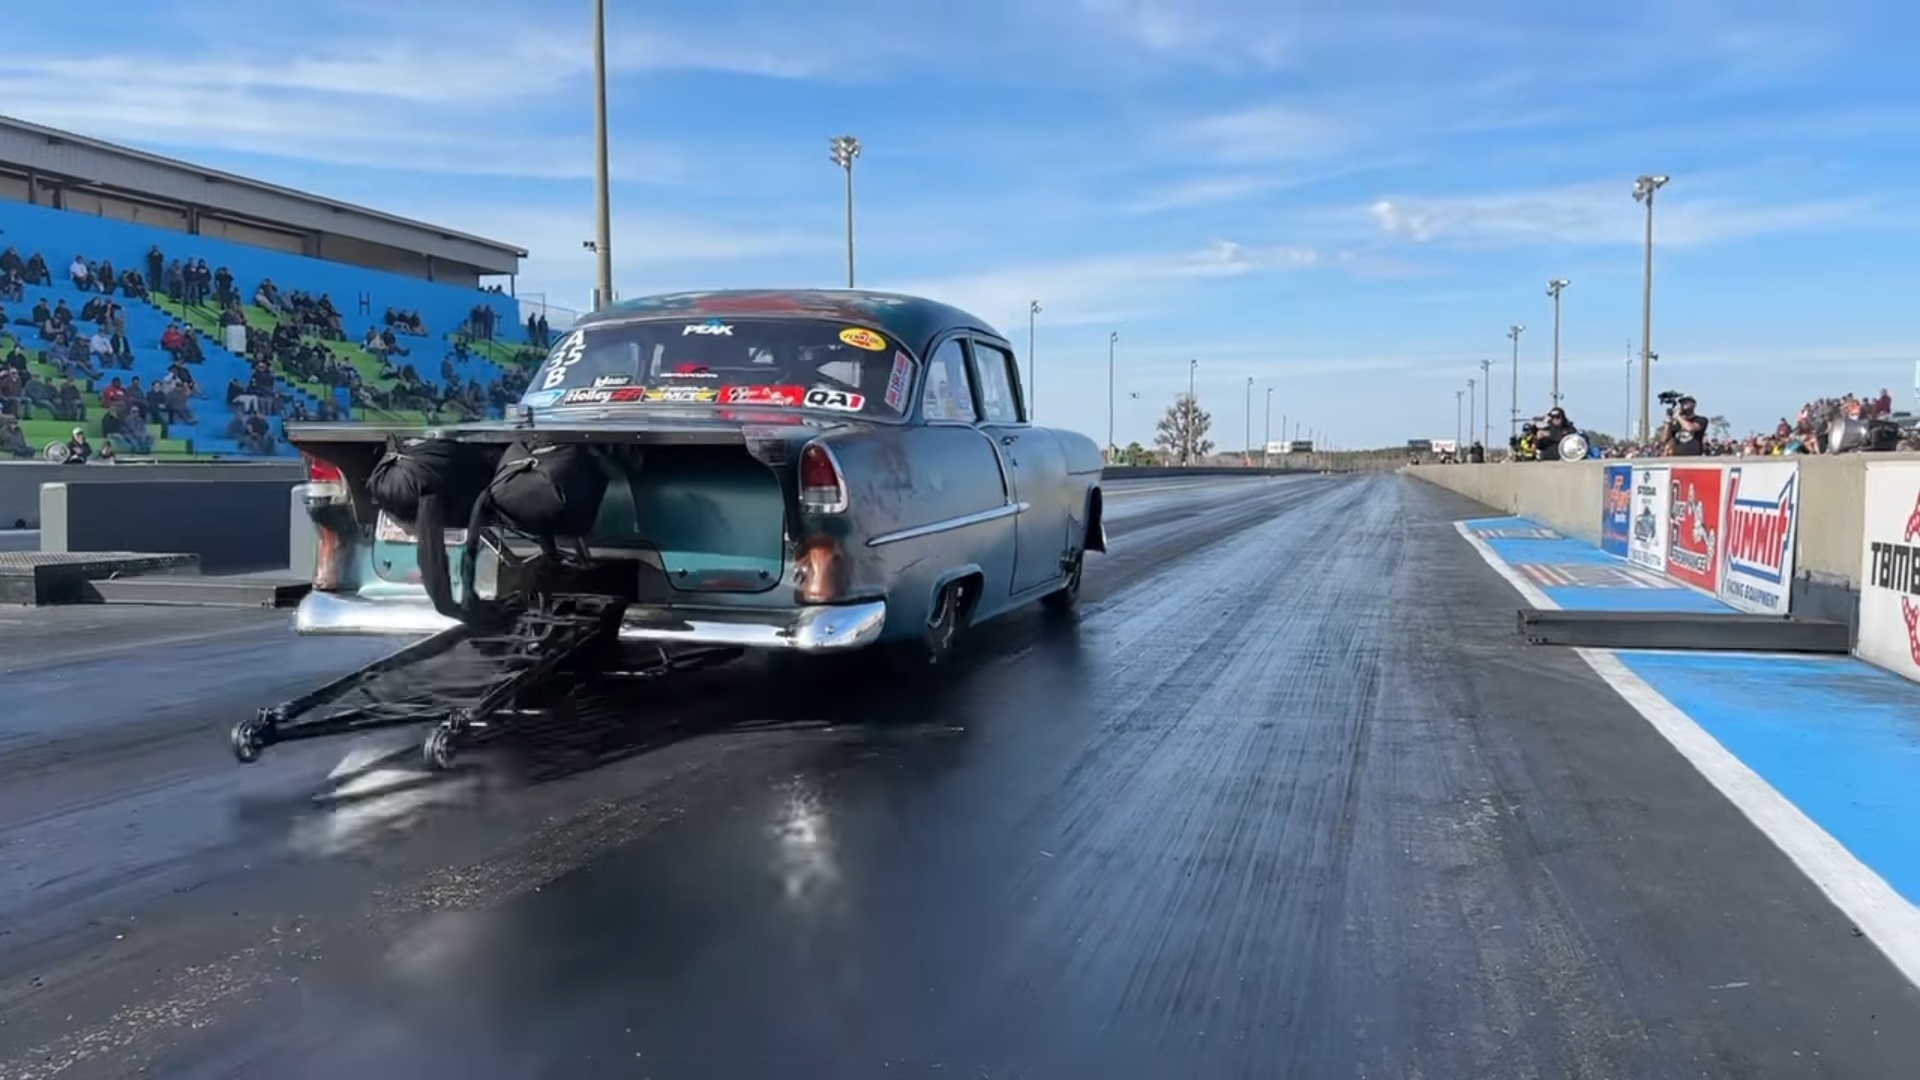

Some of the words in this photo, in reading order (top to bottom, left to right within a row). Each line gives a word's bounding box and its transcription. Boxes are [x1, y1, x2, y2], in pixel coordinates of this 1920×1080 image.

[561, 329, 585, 350] A
[681, 324, 735, 336] PEAK
[545, 344, 587, 371] 35
[542, 366, 567, 389] B
[564, 388, 612, 404] Holley
[807, 391, 862, 409] QA1
